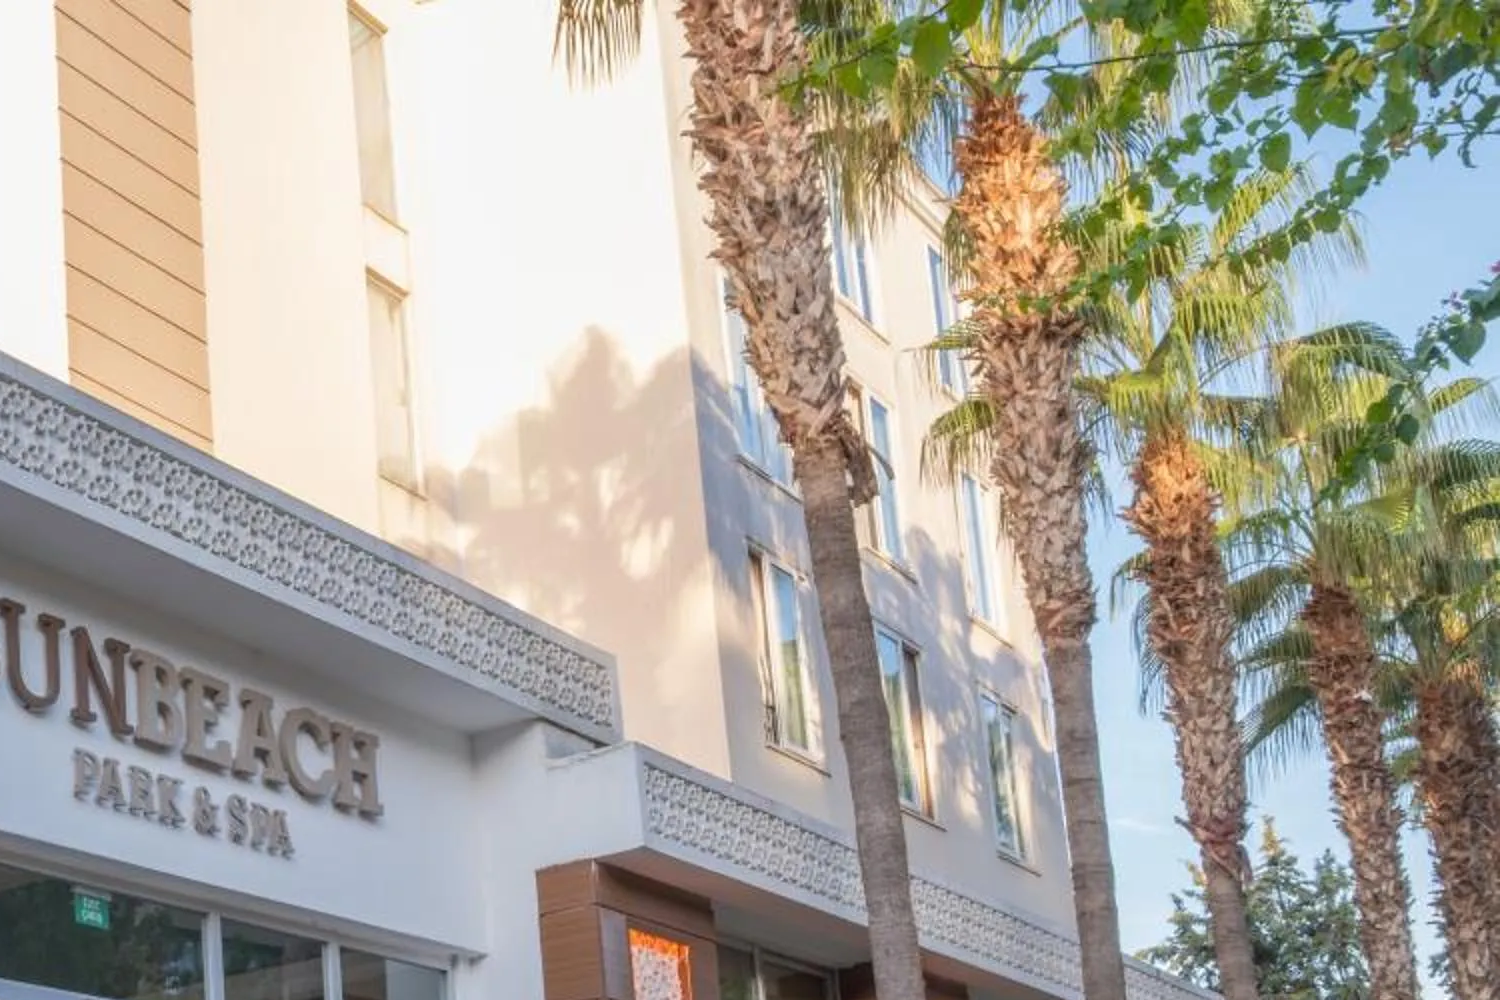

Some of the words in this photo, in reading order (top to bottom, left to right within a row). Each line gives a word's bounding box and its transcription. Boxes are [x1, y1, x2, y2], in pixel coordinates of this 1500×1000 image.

[73, 748, 186, 829] PARK
[193, 785, 223, 839] &
[226, 793, 296, 860] SPA
